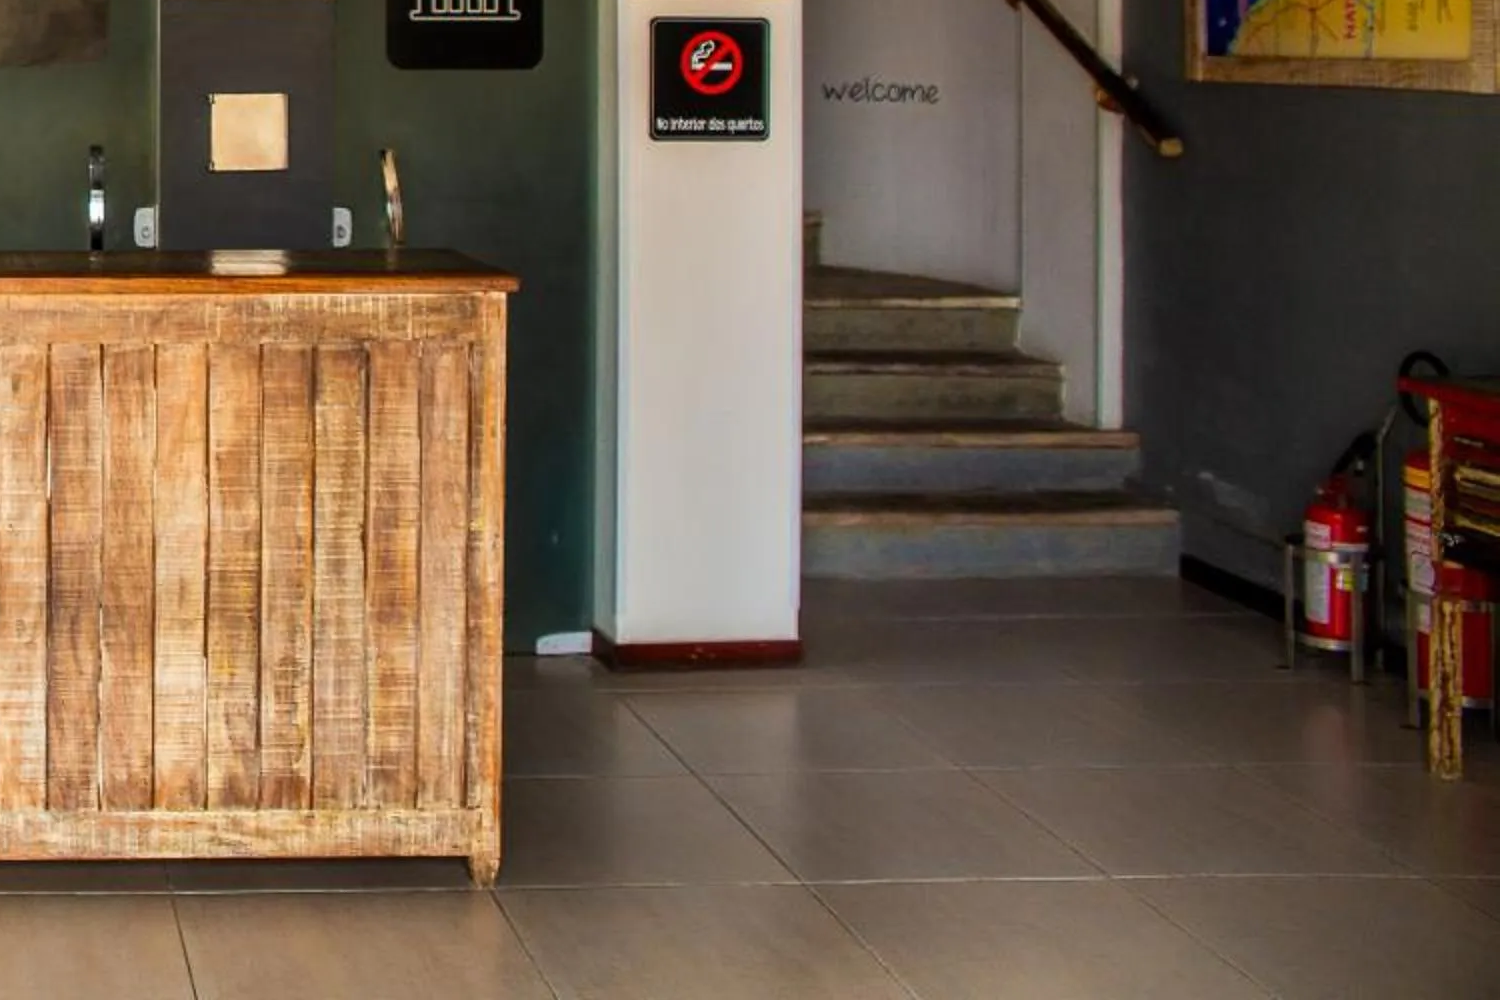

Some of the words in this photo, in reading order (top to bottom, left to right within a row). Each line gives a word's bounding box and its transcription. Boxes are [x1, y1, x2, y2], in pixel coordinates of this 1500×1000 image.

[822, 73, 940, 104] welcome
[708, 115, 726, 131] dos
[727, 117, 765, 134] quartos
